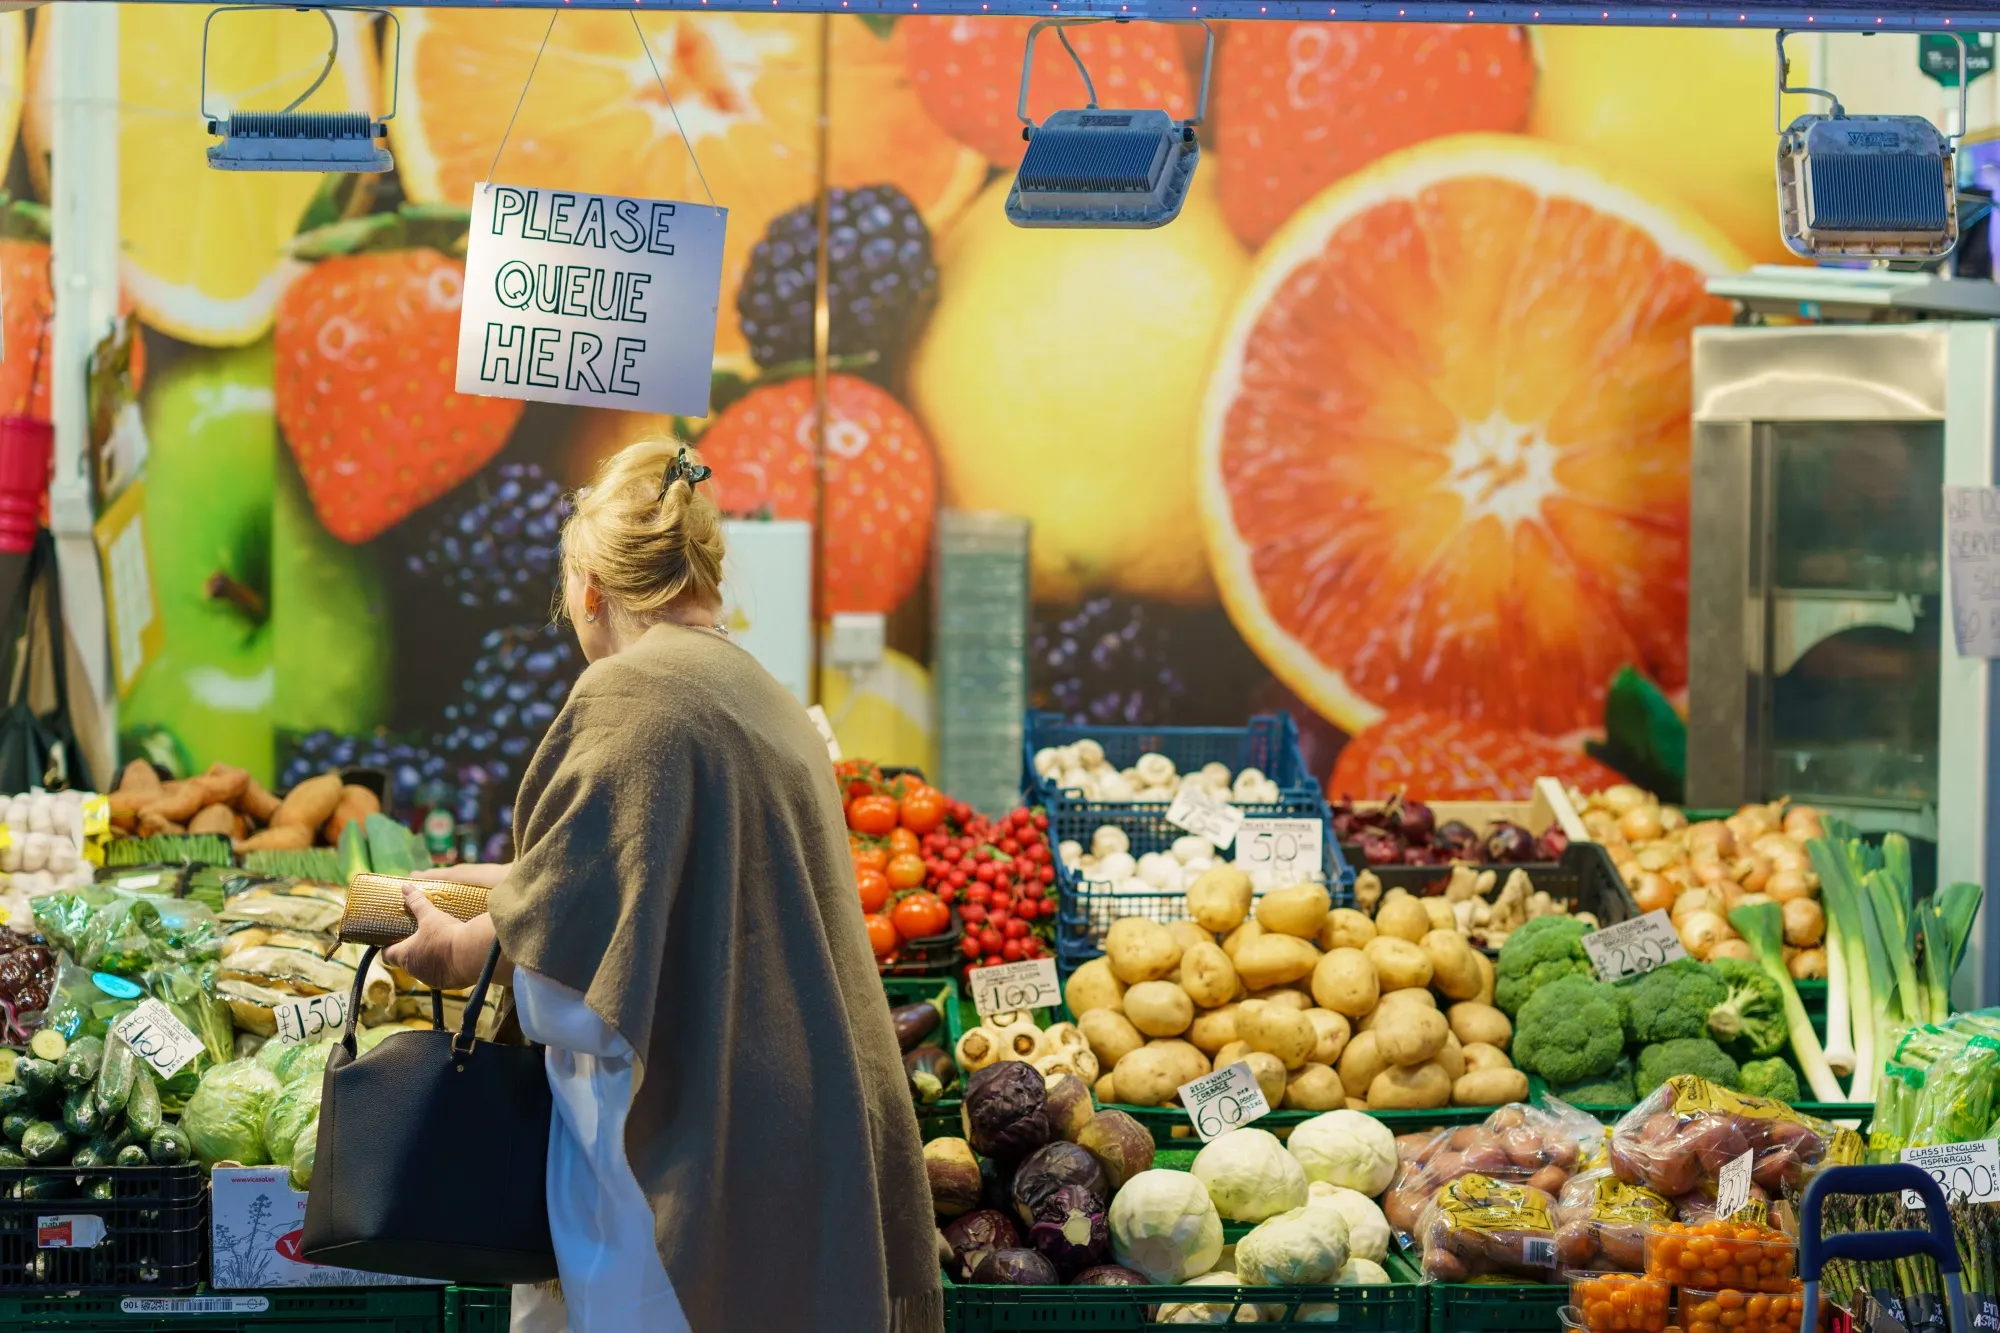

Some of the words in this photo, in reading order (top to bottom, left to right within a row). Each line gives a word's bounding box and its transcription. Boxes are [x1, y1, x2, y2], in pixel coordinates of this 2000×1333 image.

[492, 187, 675, 255] PLEASE
[495, 260, 651, 323] QUEUE
[480, 323, 646, 396] HERE
[148, 1012, 181, 1042] CUCUMBER
[173, 1022, 194, 1041] DUTCH
[1909, 1148, 1939, 1159] CLASS
[1946, 1142, 1985, 1153] ENGLISH
[1921, 1155, 1972, 1166] ASPARAGUS
[231, 1176, 276, 1184] www.vicasol.es
[1990, 1164, 2000, 1193] EACH
[123, 1301, 138, 1309] 106
